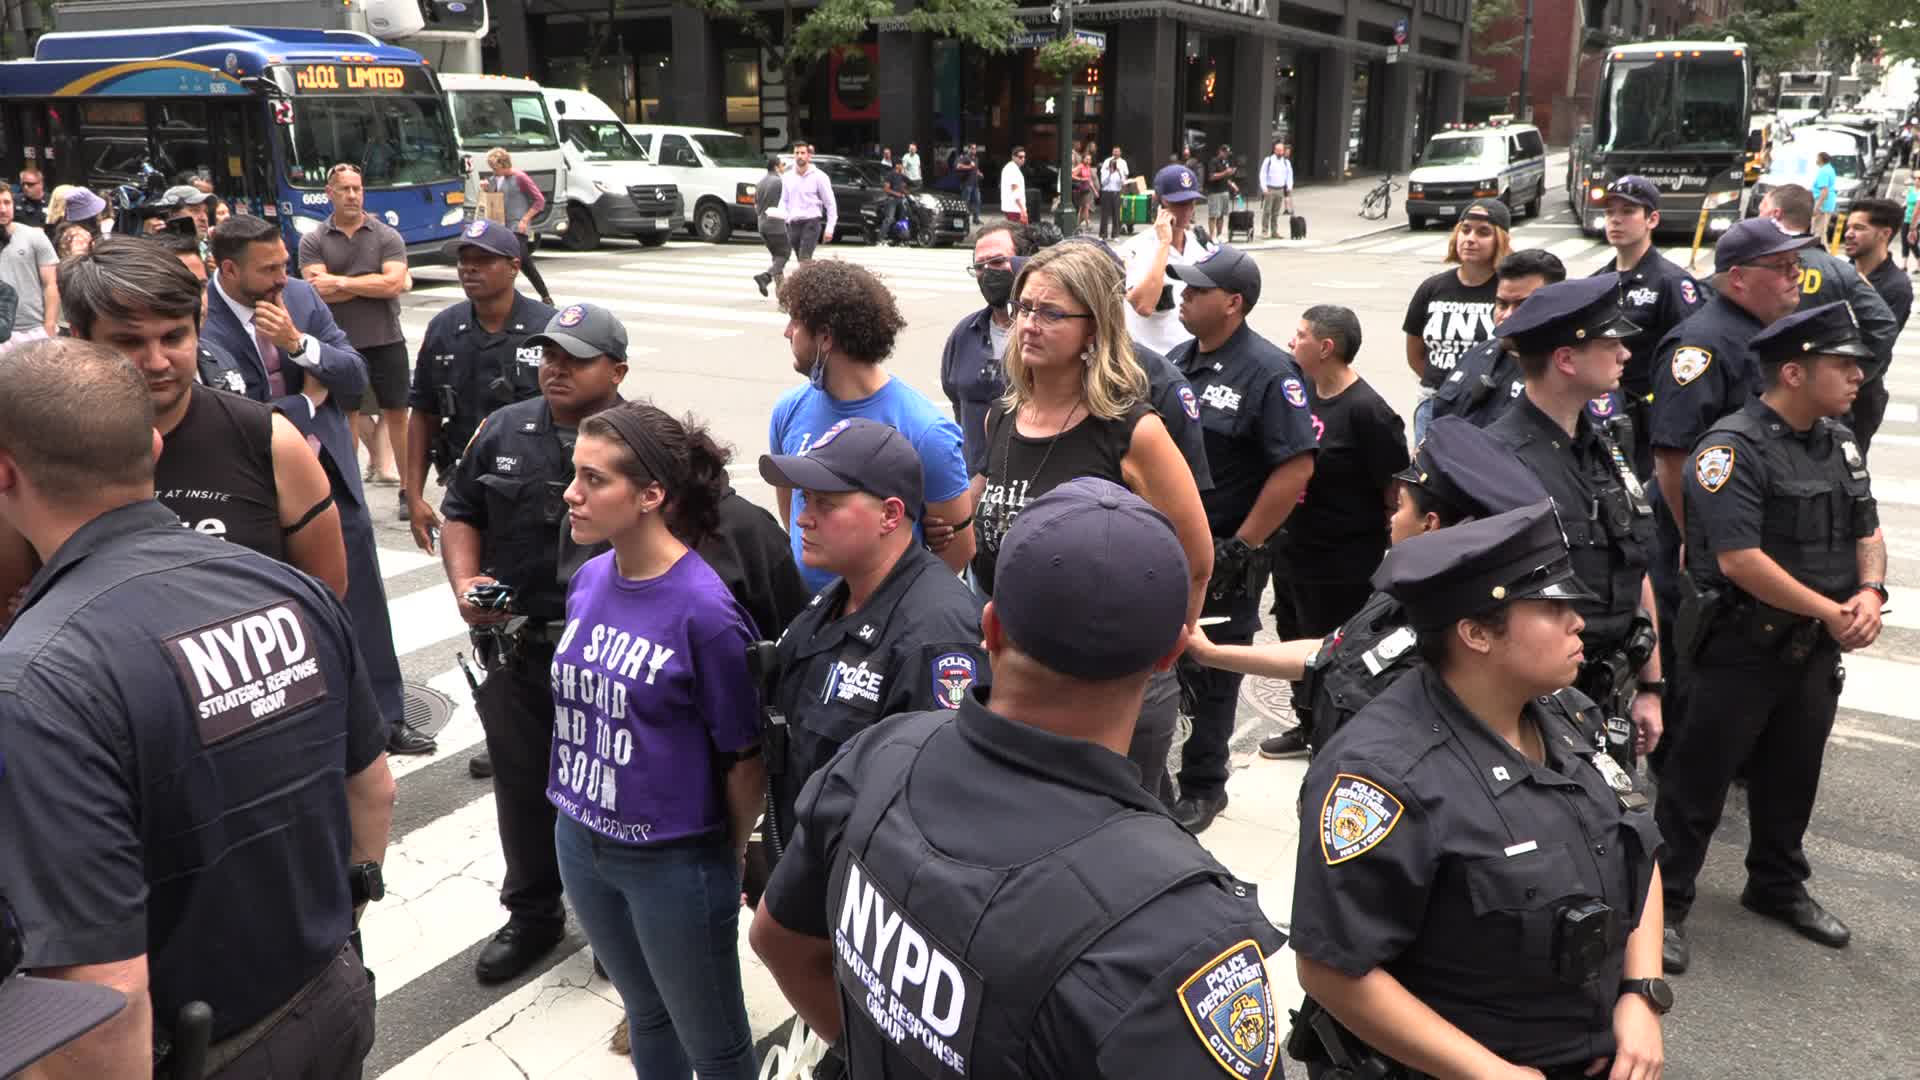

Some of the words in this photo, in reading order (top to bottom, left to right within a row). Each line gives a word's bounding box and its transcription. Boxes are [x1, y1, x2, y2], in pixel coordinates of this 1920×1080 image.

[346, 67, 405, 88] LIMITED
[1428, 301, 1495, 313] RECOVERY
[1423, 312, 1496, 340] ANY
[516, 346, 542, 359] POLI
[1425, 340, 1479, 354] OSIT
[1429, 351, 1463, 370] CHA
[164, 489, 183, 498] AT
[185, 489, 232, 502] INSITE
[981, 477, 1028, 507] rail
[178, 606, 306, 698] NYPD
[556, 618, 580, 655] O
[583, 623, 675, 685] STORY
[938, 656, 973, 671] POLICE
[199, 680, 266, 719] STRATEGIC
[265, 657, 319, 693] RESPONSE
[250, 689, 287, 719] GROUP
[553, 705, 587, 746] ND
[595, 716, 634, 766] TOO
[557, 744, 617, 812] SOON
[1350, 781, 1386, 804] POLICE
[1324, 806, 1333, 829] CITY
[1334, 787, 1393, 822] DEPARTMENT
[1324, 831, 1332, 845] OF
[1340, 843, 1361, 857] NEW
[1360, 826, 1386, 847] YORK
[839, 863, 966, 1036] NYPD
[1205, 953, 1248, 991] POLICE
[835, 928, 887, 1004] STRATEGIC
[889, 995, 966, 1076] RESPONSE
[1196, 963, 1263, 1020] DEPARTMENT
[1264, 982, 1276, 1028] YORK
[866, 993, 906, 1045] GROUP
[1209, 1034, 1236, 1063] CITY
[1235, 1060, 1252, 1076] OF
[1264, 1033, 1276, 1066] NEW
